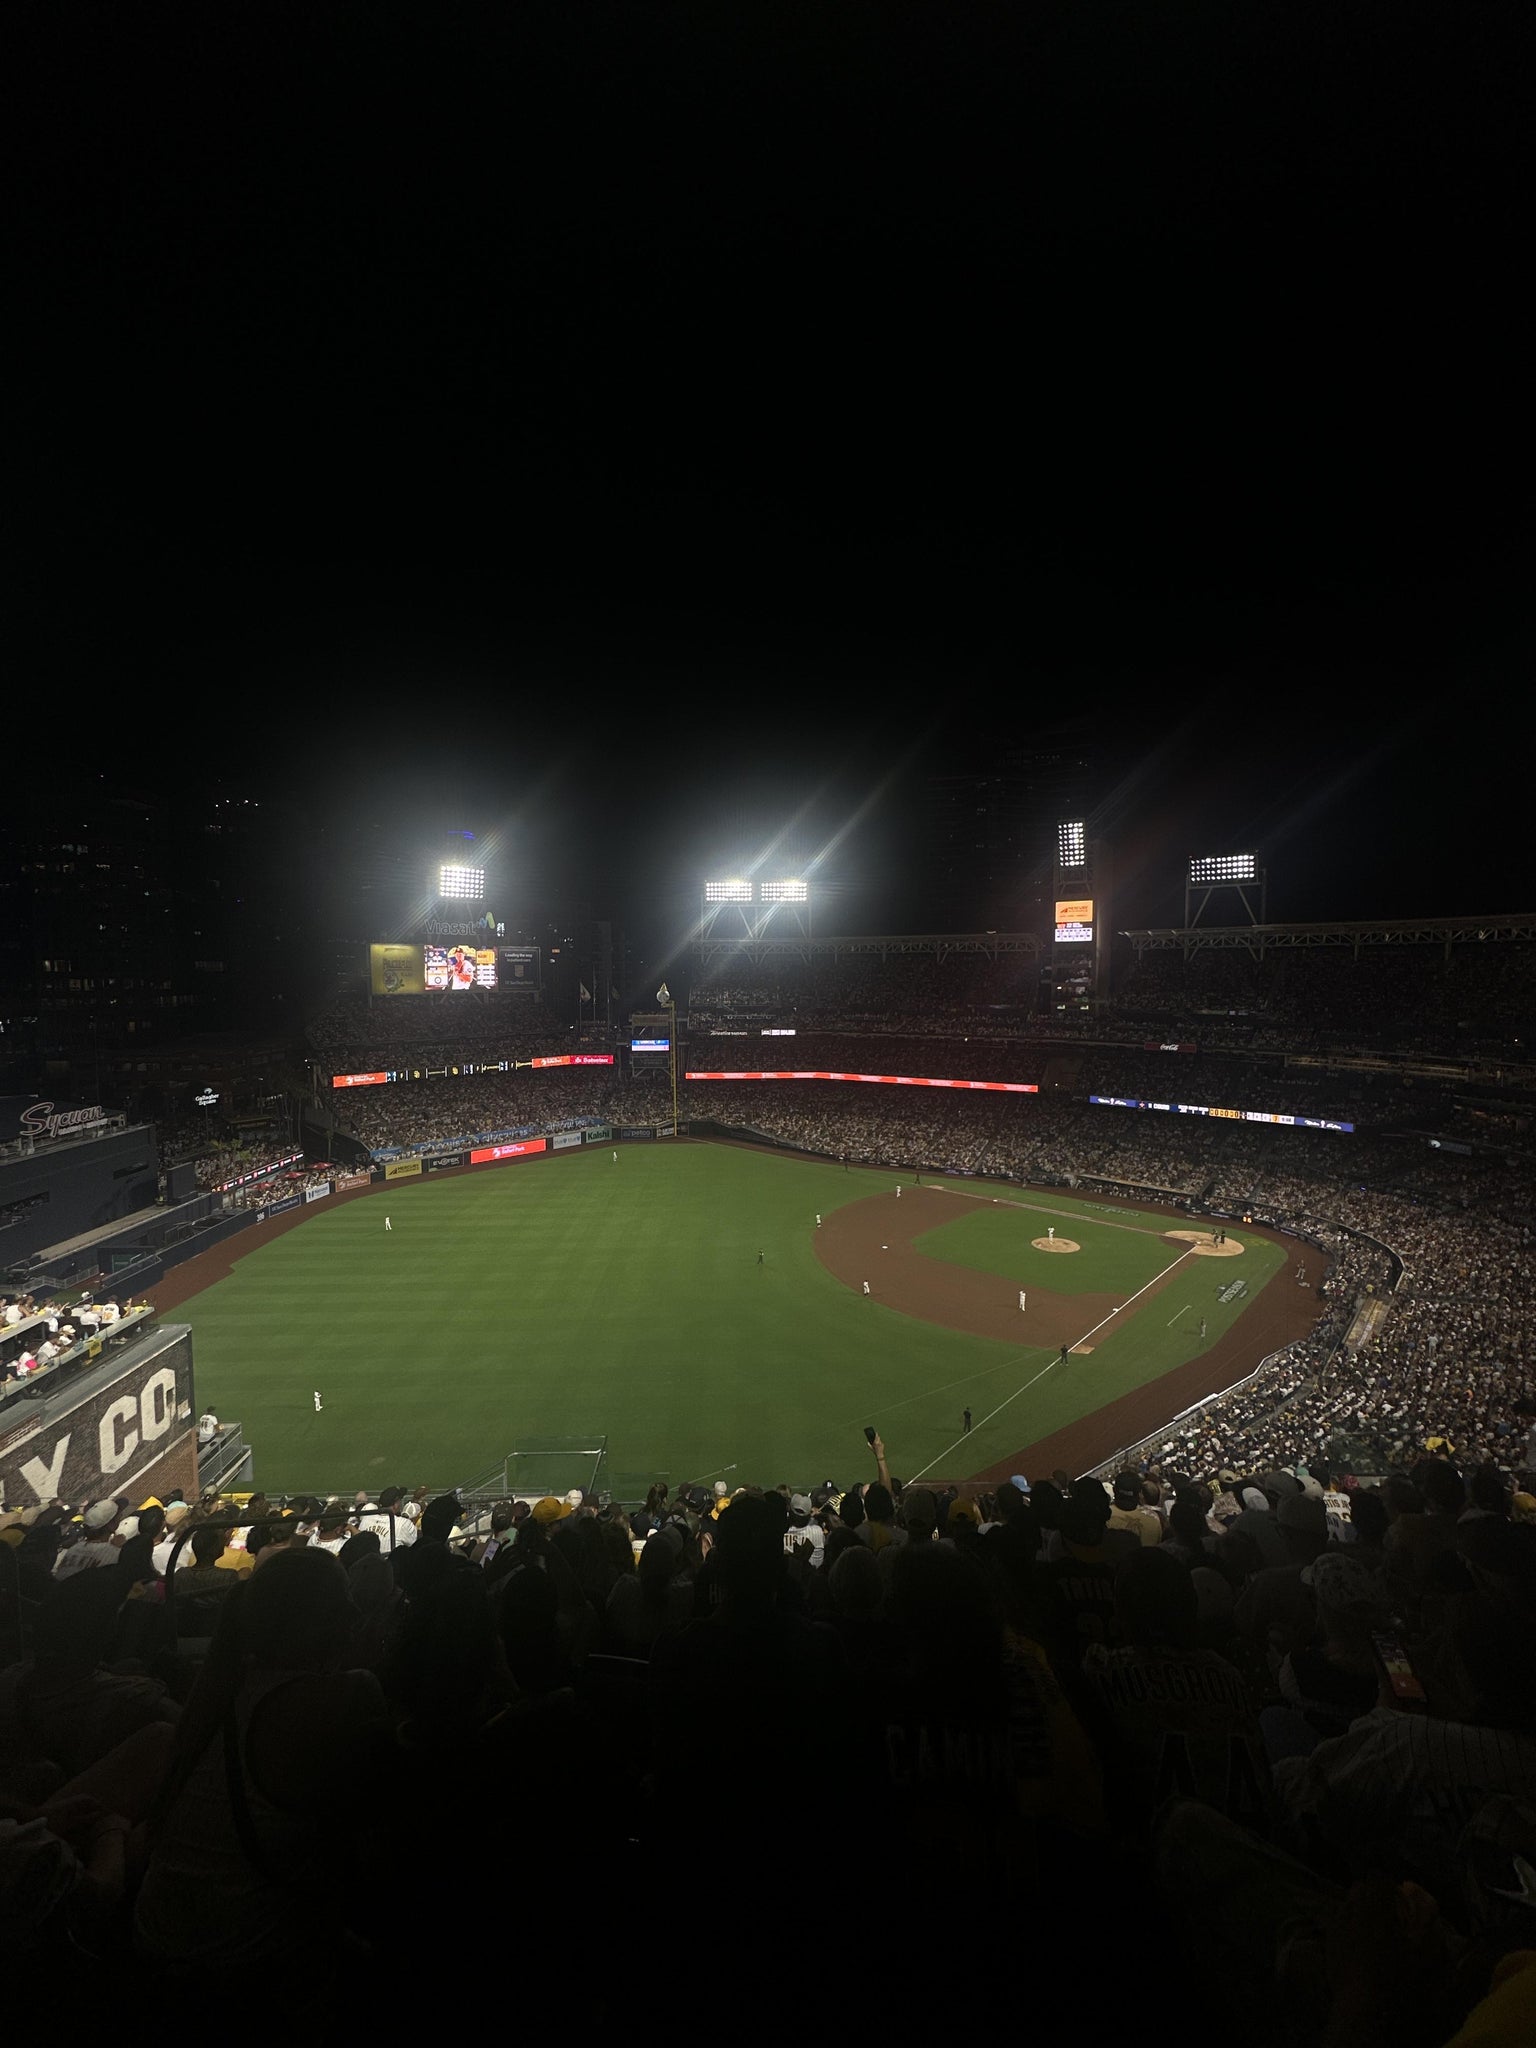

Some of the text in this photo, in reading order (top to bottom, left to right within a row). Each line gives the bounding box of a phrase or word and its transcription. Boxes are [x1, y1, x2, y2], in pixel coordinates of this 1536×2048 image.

[424, 919, 477, 935] Viasat
[20, 1101, 106, 1138] Sycuan
[587, 1129, 610, 1140] Kalshi
[99, 1367, 190, 1473] CO.
[366, 1525, 389, 1537] ERRILL
[784, 1535, 798, 1547] TIS
